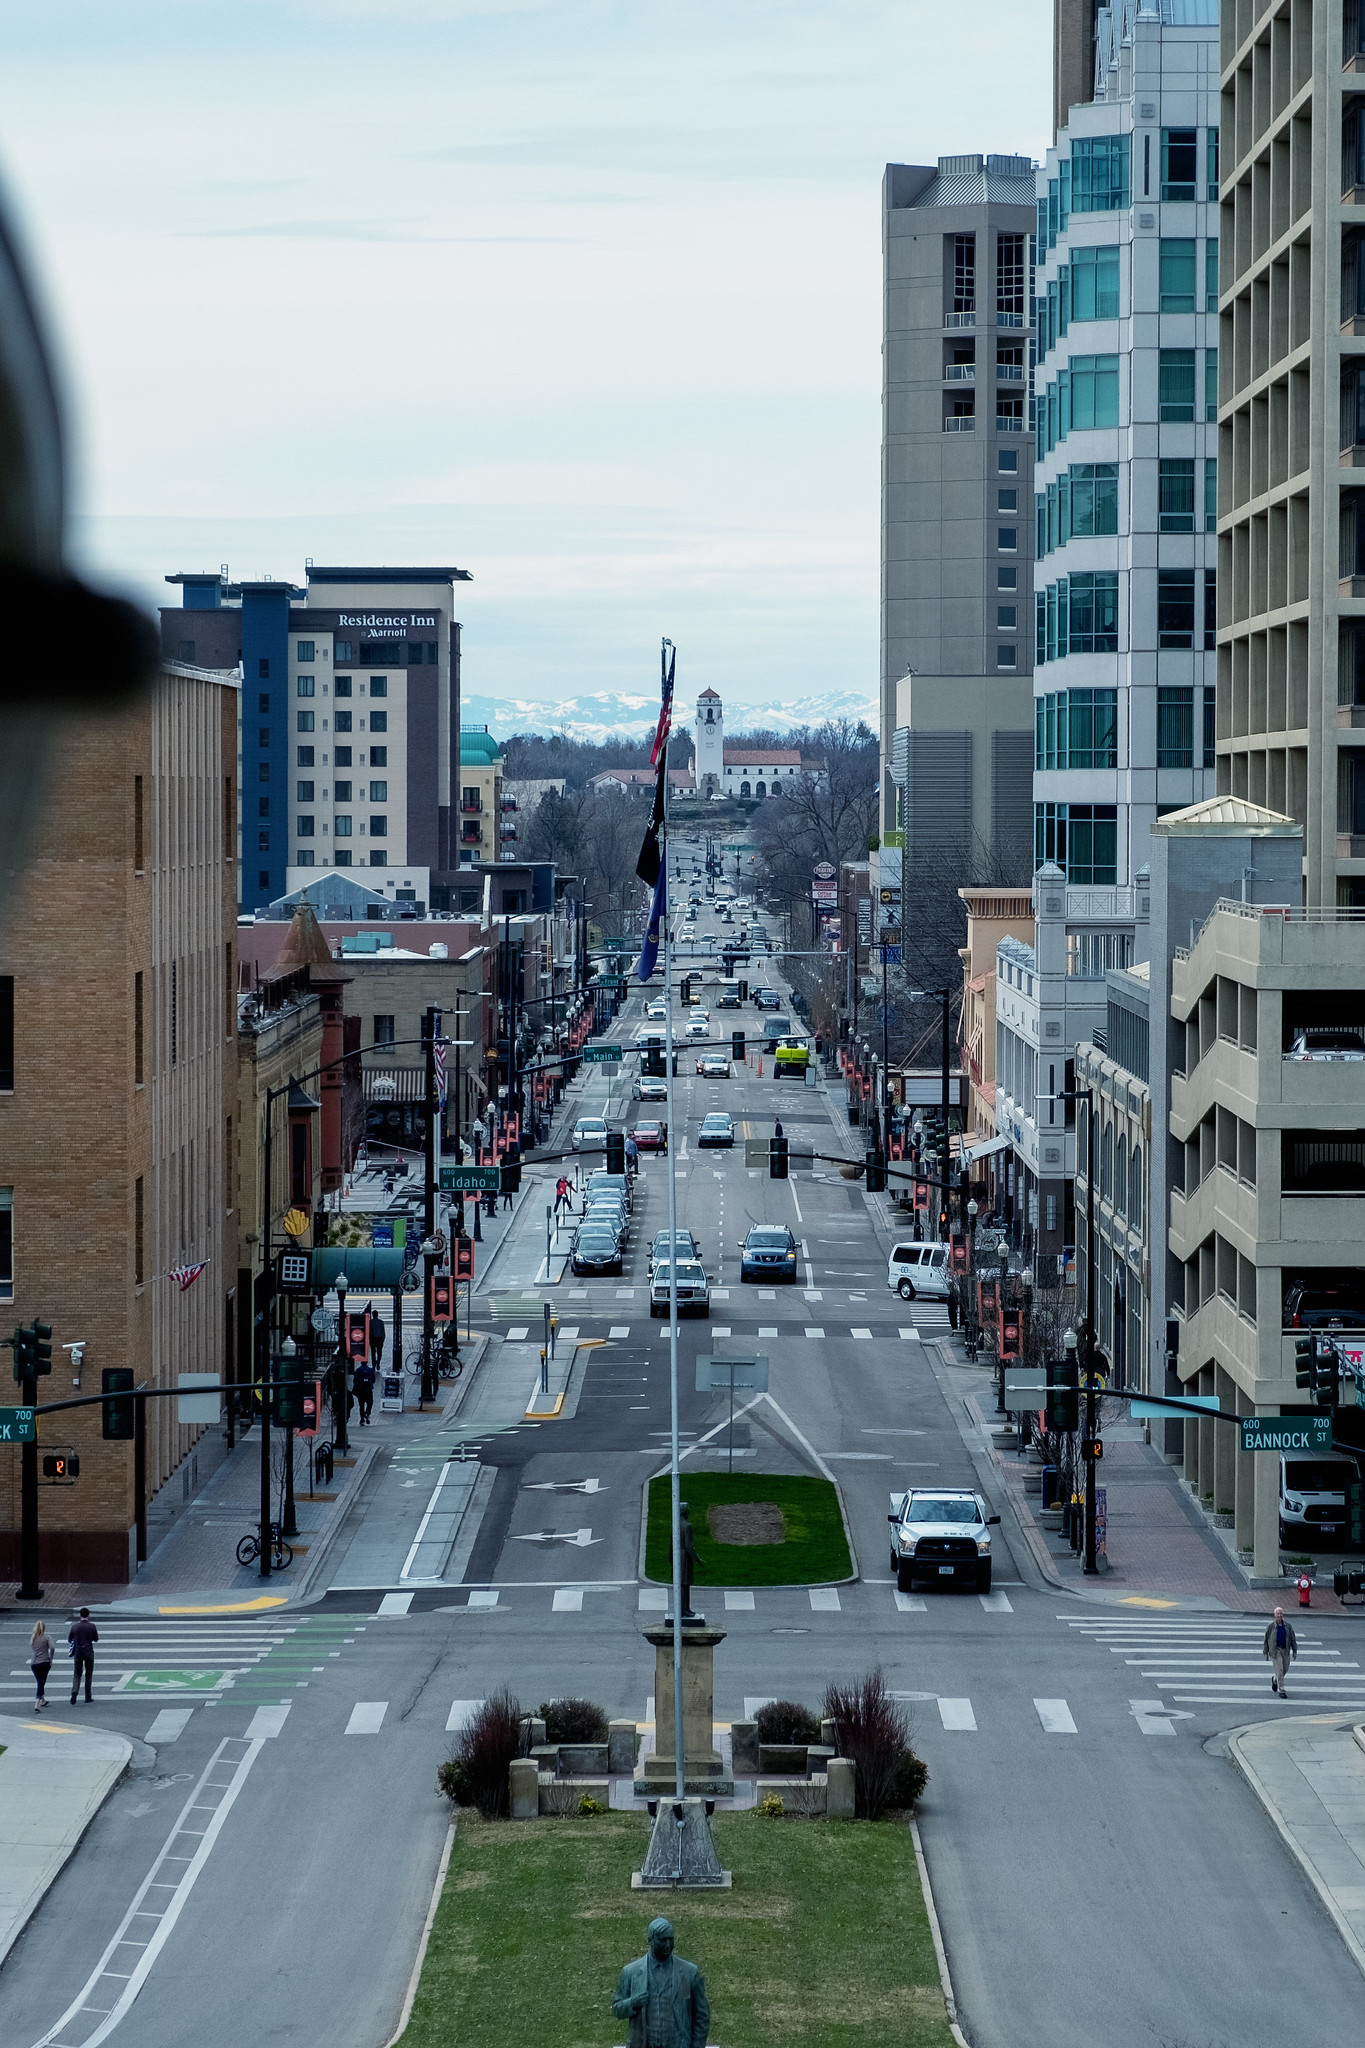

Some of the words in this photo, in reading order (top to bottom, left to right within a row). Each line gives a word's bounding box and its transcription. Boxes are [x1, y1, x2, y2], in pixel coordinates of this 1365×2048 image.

[339, 614, 408, 627] Residence
[410, 614, 436, 627] Inn
[367, 628, 407, 638] Marriott
[593, 1052, 613, 1061] Main
[452, 1176, 486, 1188] Idaho
[15, 1410, 32, 1420] 700
[1243, 1419, 1260, 1429] 600
[1312, 1418, 1330, 1428] 700
[18, 1424, 29, 1434] ST
[1245, 1432, 1310, 1449] BANNOCK
[1316, 1432, 1327, 1442] ST
